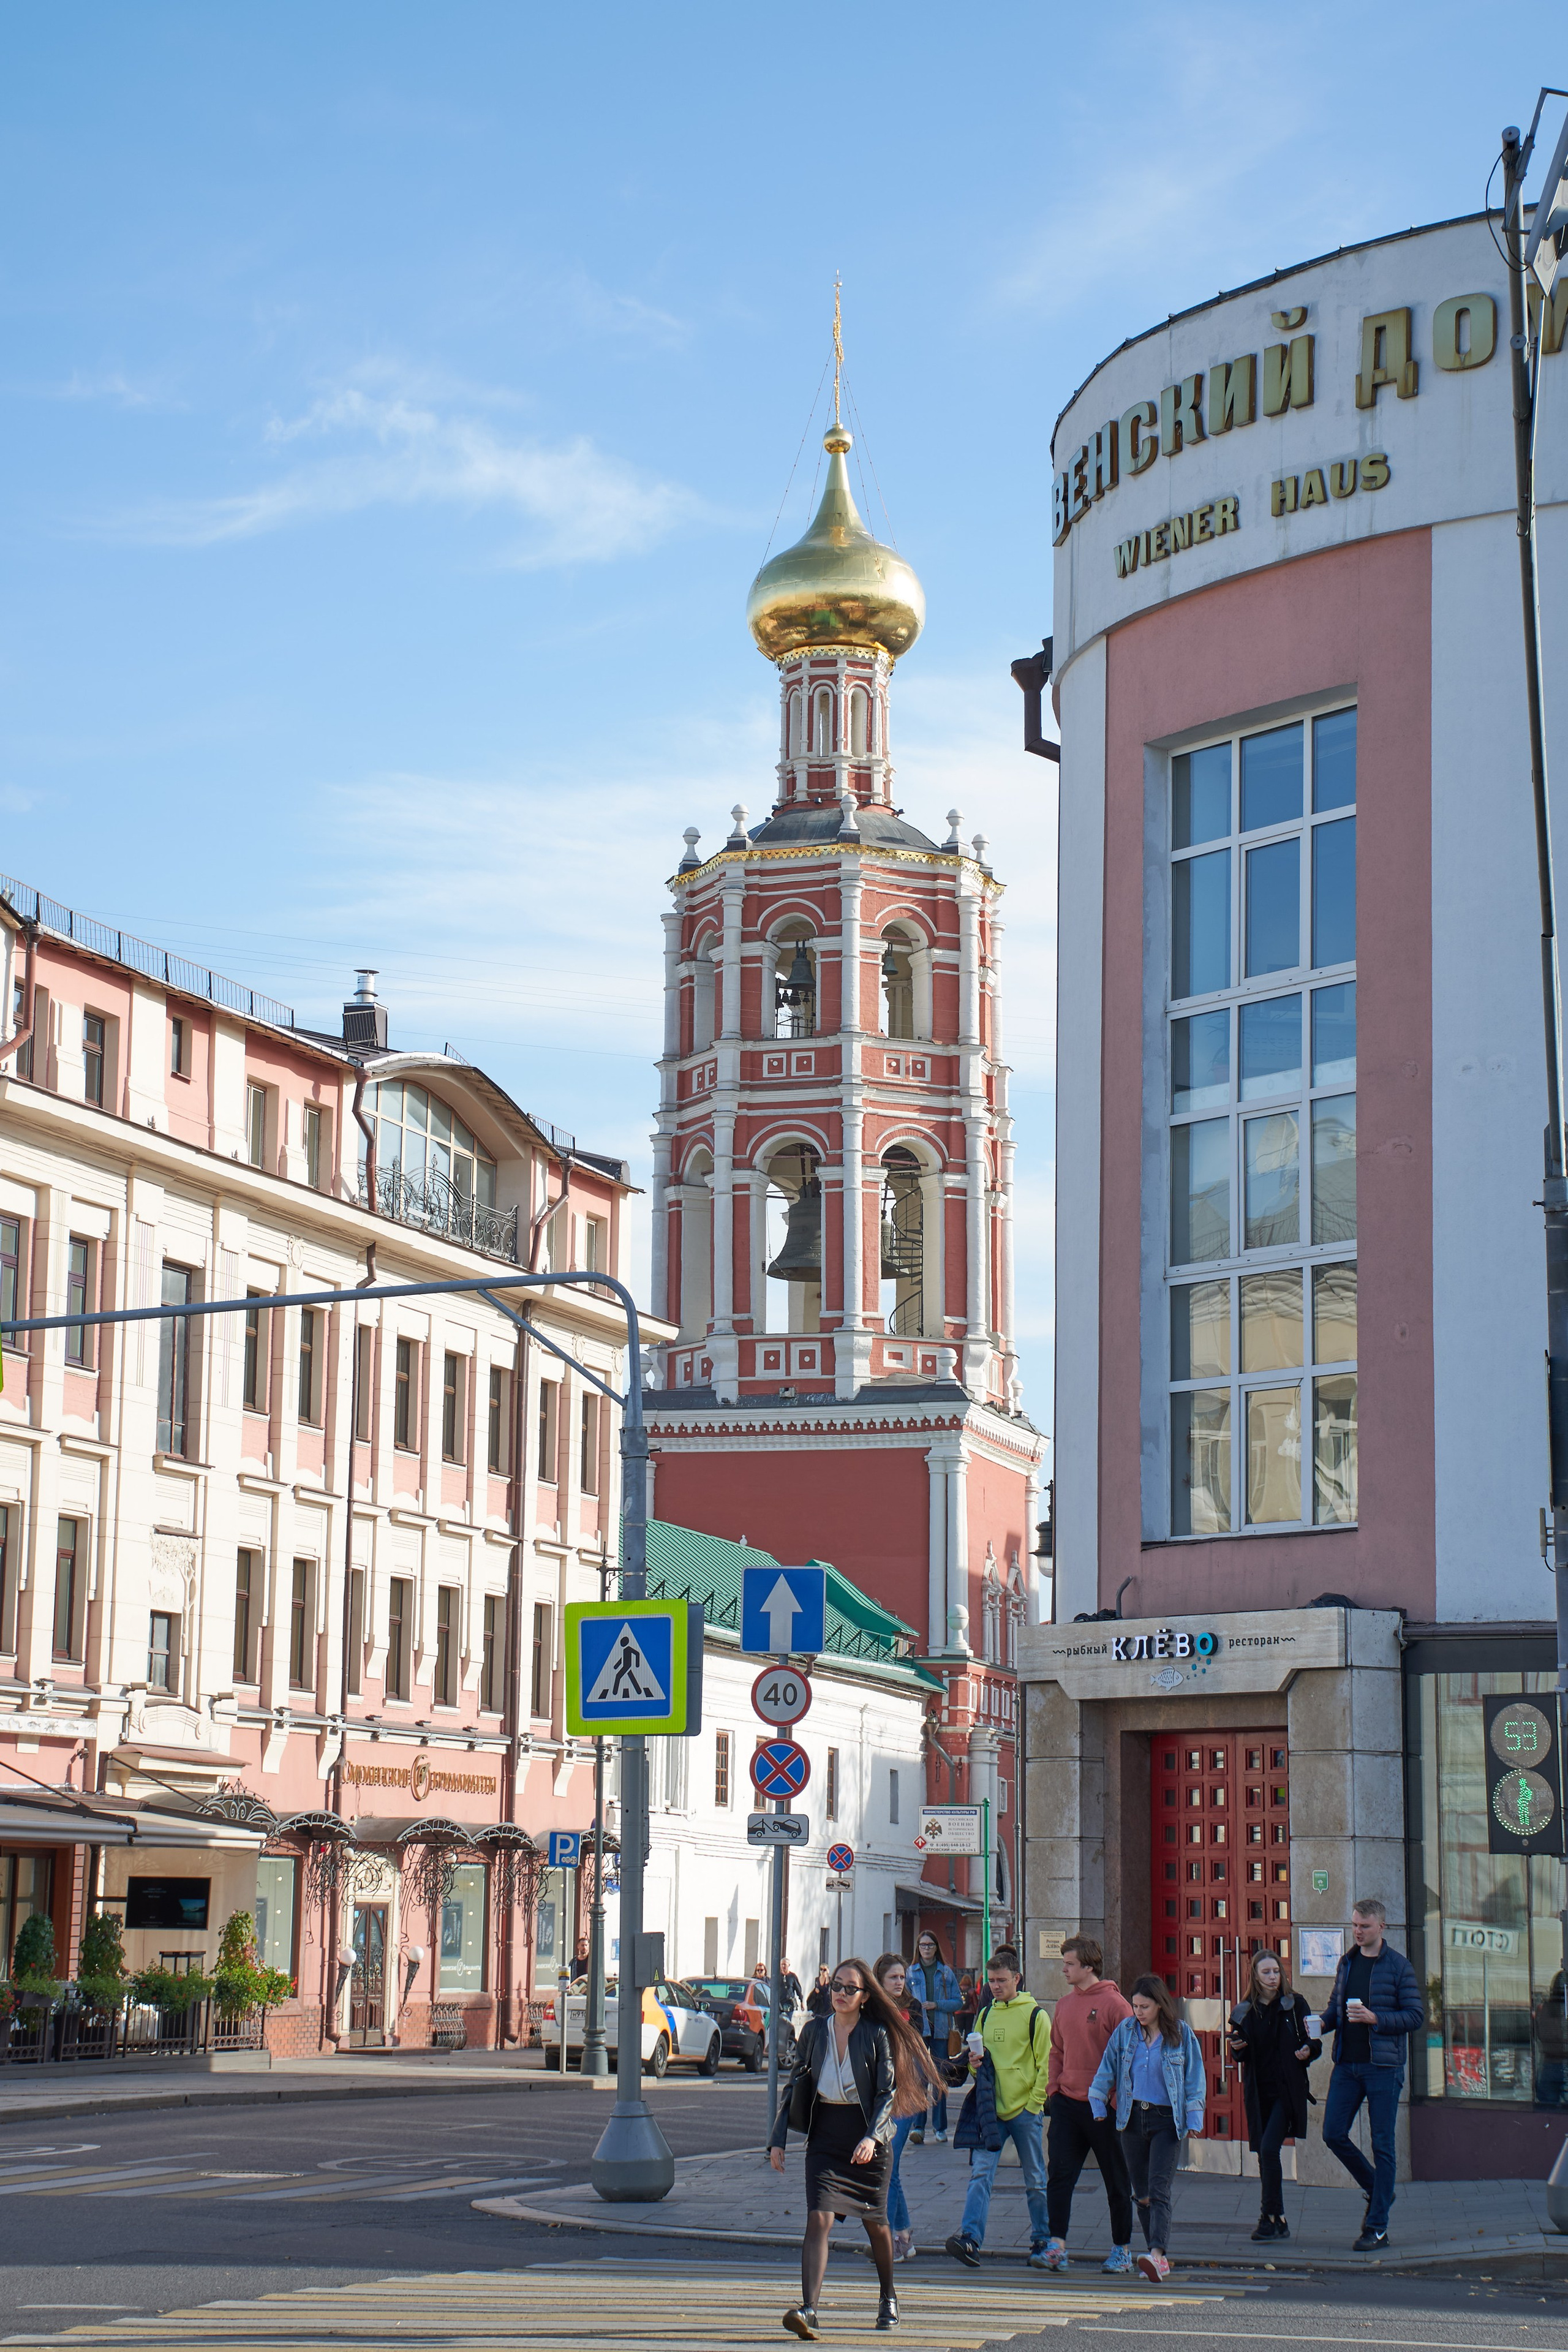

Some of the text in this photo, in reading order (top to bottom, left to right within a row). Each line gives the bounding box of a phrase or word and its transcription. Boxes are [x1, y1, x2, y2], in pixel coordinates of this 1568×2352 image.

[1052, 307, 1314, 547] ВЕНСКИЙ
[1114, 453, 1391, 578] WIENER HAUS
[1066, 1629, 1281, 1660] рыбный КЛЁВО ресторан
[763, 1683, 797, 1706] 40
[1504, 1721, 1537, 1751] 53
[556, 1834, 575, 1864] P
